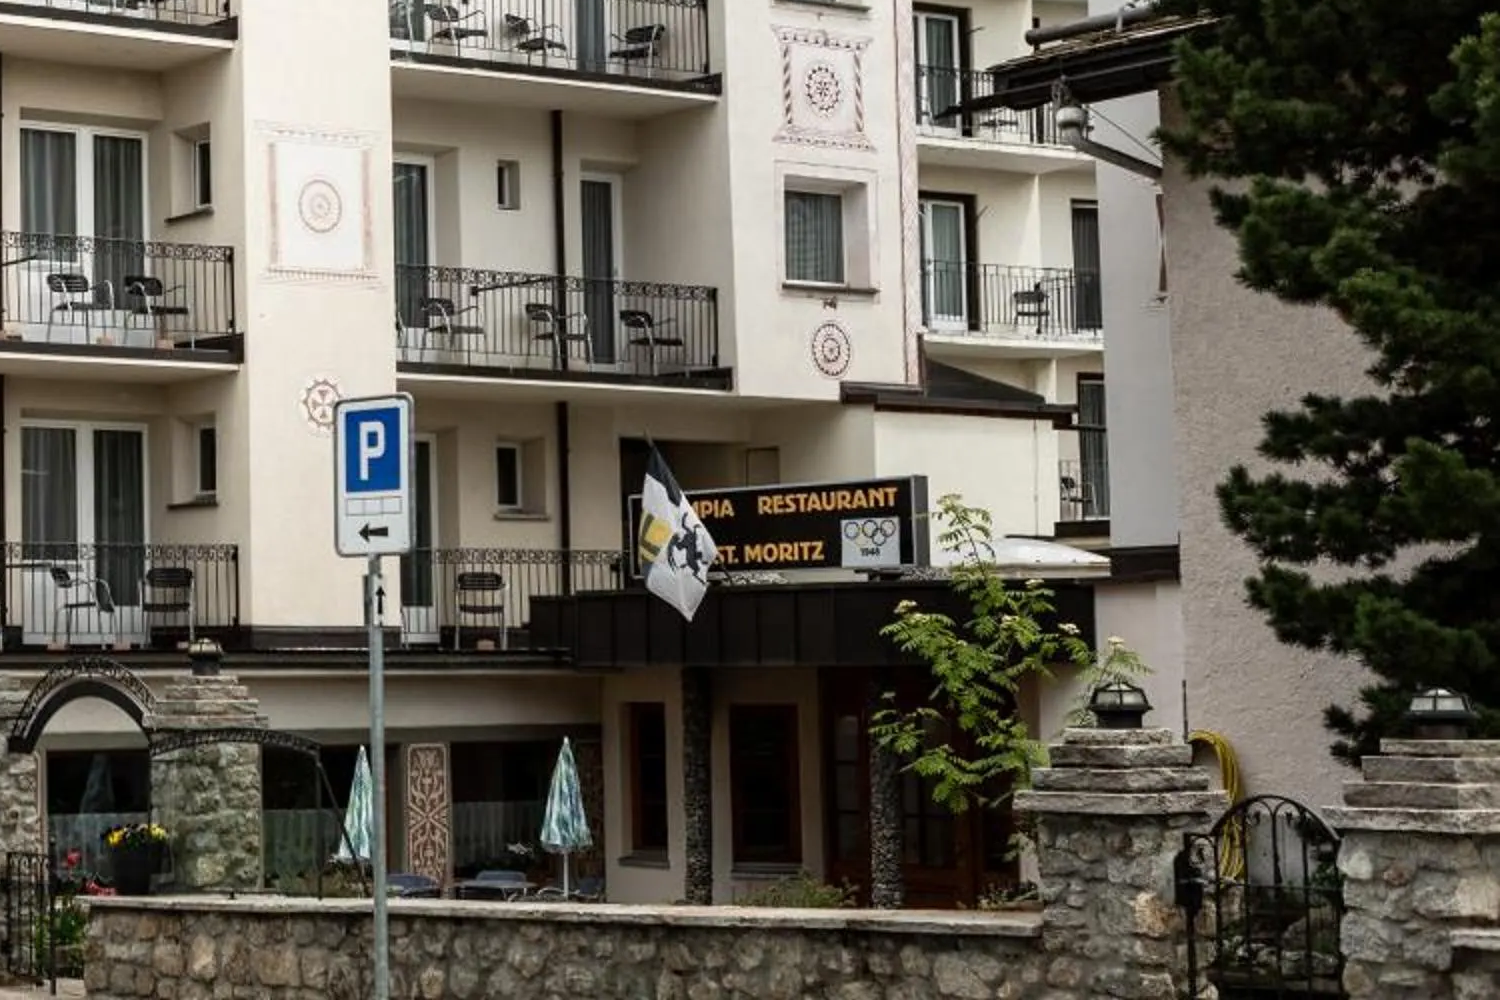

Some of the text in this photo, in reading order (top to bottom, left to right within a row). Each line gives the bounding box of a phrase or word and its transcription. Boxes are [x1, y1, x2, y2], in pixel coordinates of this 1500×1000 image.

[359, 421, 386, 481] P
[757, 487, 898, 516] RESTAURANT
[744, 540, 825, 564] MORITZ
